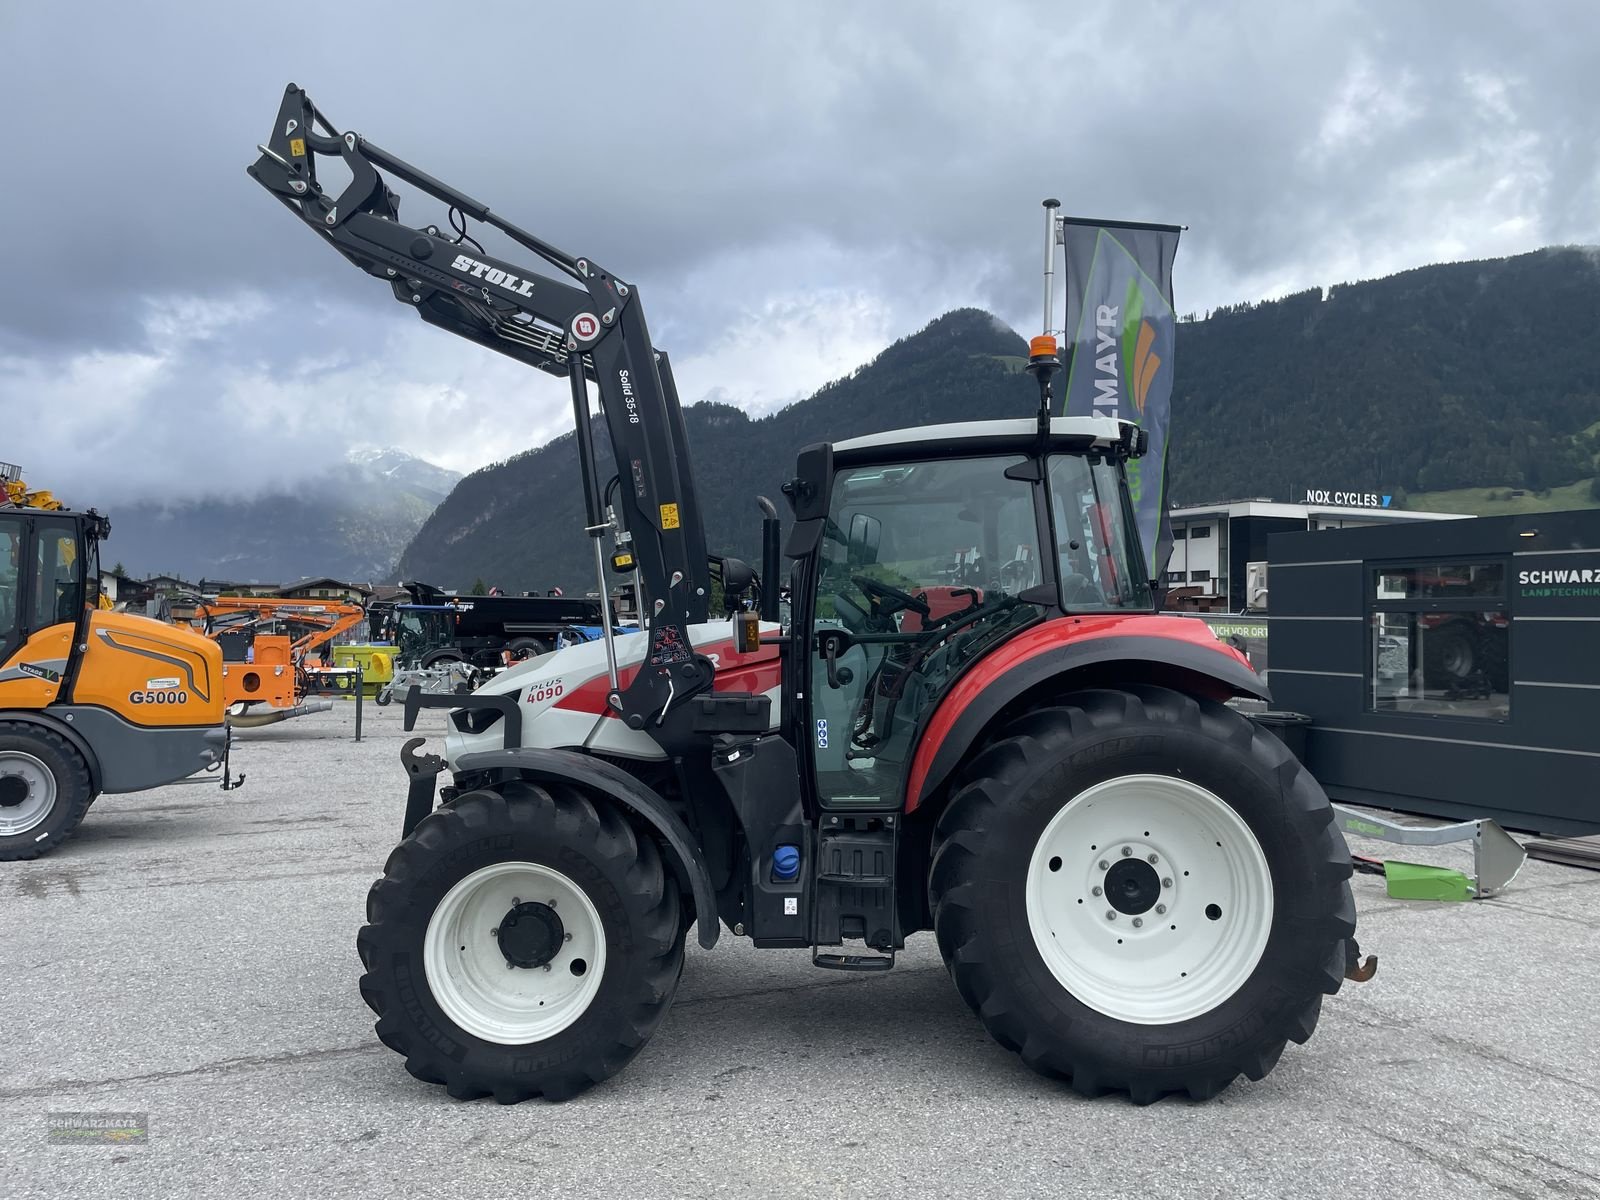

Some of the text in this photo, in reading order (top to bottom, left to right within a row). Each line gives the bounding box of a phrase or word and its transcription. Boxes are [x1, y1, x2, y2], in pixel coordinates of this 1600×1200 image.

[451, 254, 535, 298] STOLL
[619, 369, 640, 424] Solid 35-18
[1306, 489, 1378, 506] NOX CYCLES
[1231, 626, 1249, 637] VOR
[22, 665, 43, 677] STAGE
[530, 677, 562, 692] PLUS
[129, 690, 188, 705] G5000
[526, 685, 564, 704] 4090
